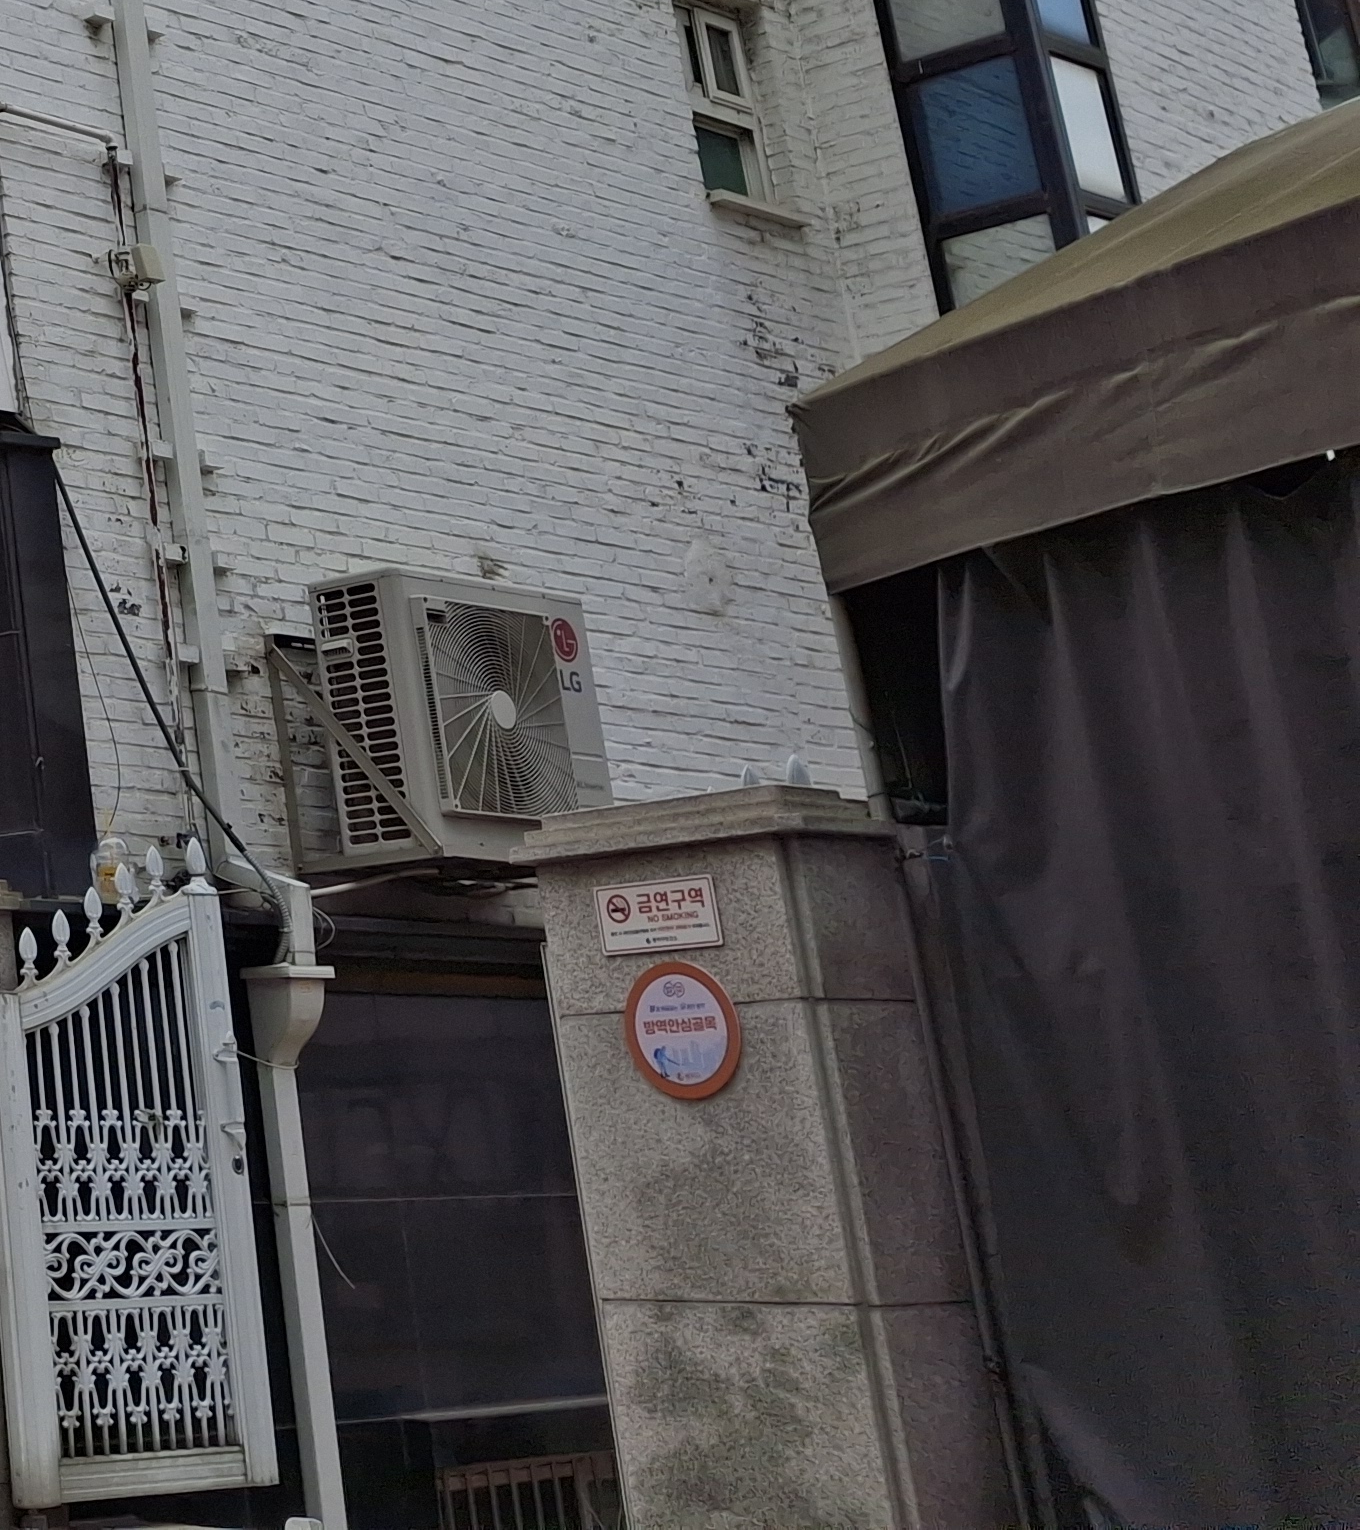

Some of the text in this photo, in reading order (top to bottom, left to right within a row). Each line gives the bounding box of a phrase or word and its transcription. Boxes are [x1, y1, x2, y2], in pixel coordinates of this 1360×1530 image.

[560, 669, 583, 694] LG
[636, 886, 706, 914] 금연구역
[647, 911, 700, 923] NO SMOKING
[642, 1015, 718, 1037] 방역안심골목
